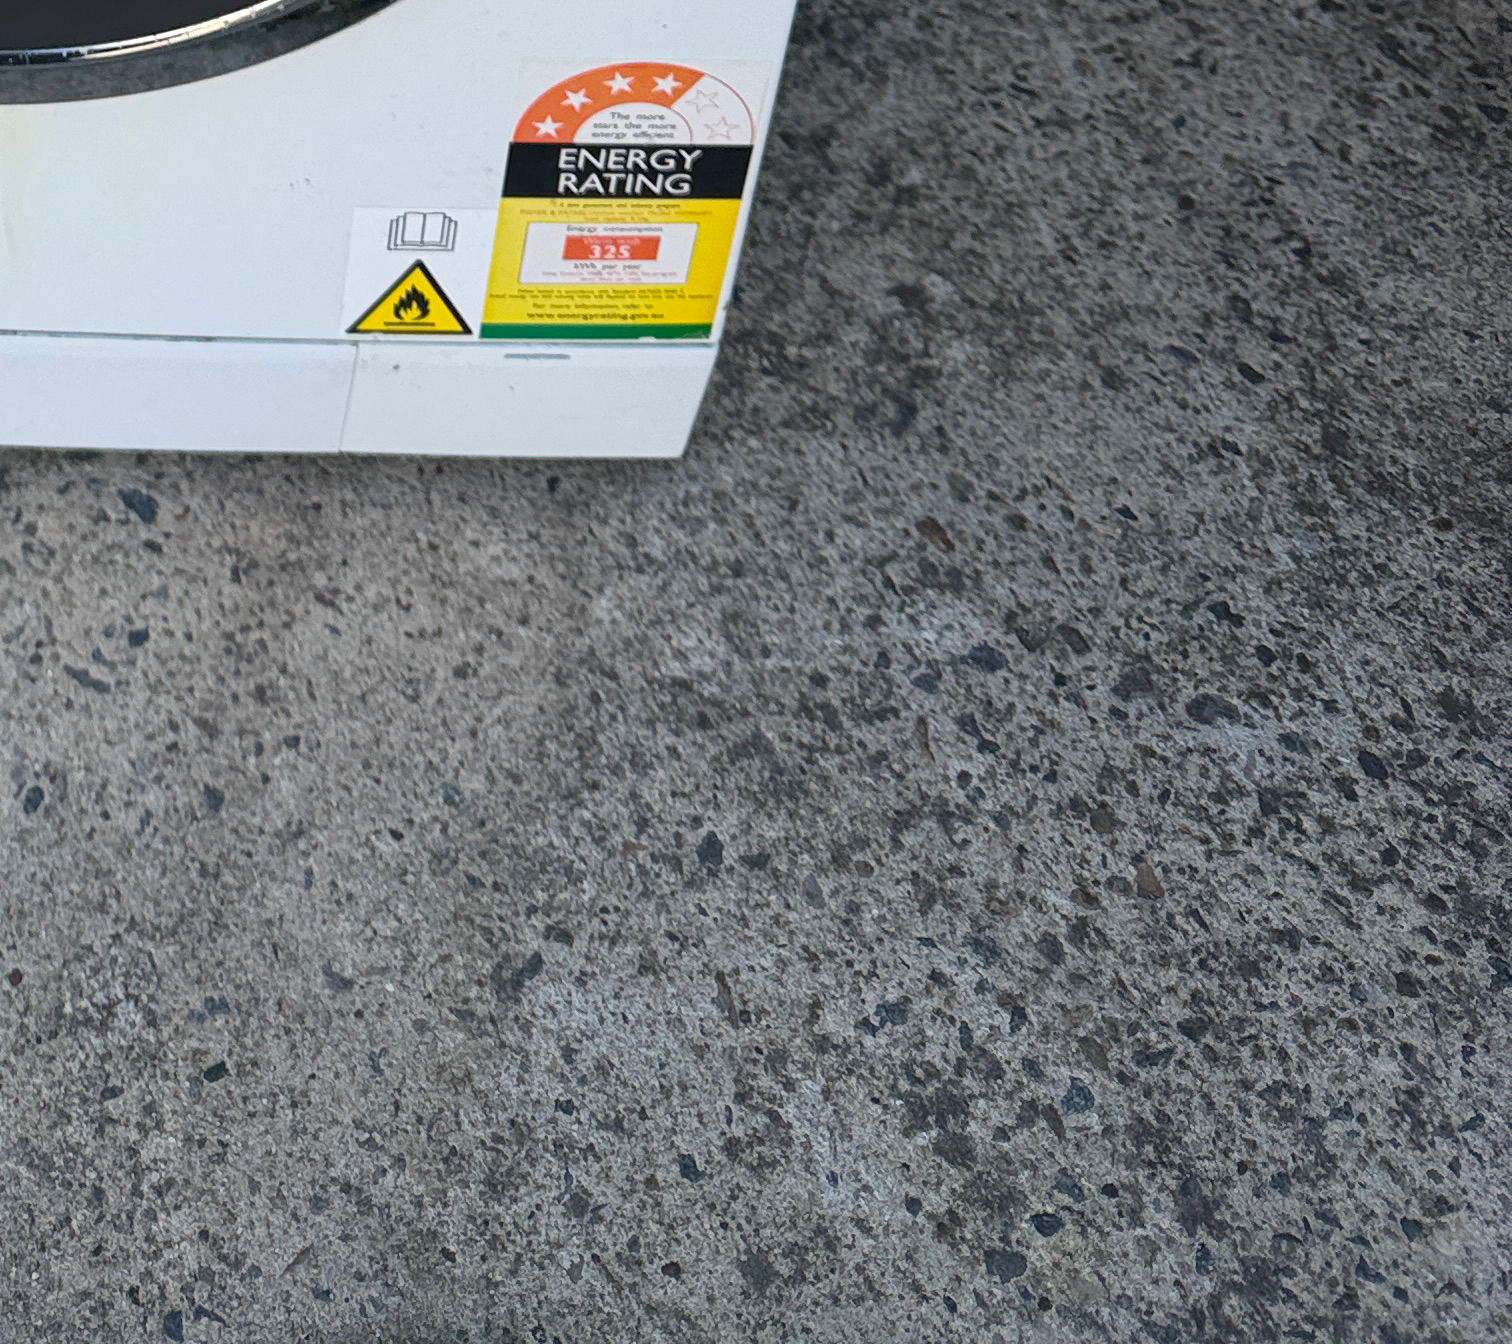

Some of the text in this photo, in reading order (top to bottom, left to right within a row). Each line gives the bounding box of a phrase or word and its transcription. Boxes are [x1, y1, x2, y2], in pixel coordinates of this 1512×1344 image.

[610, 111, 665, 121] The more
[591, 131, 675, 140] energy efficient
[557, 148, 704, 172] ENERGY
[557, 173, 694, 196] RATING
[588, 244, 631, 259] 325
